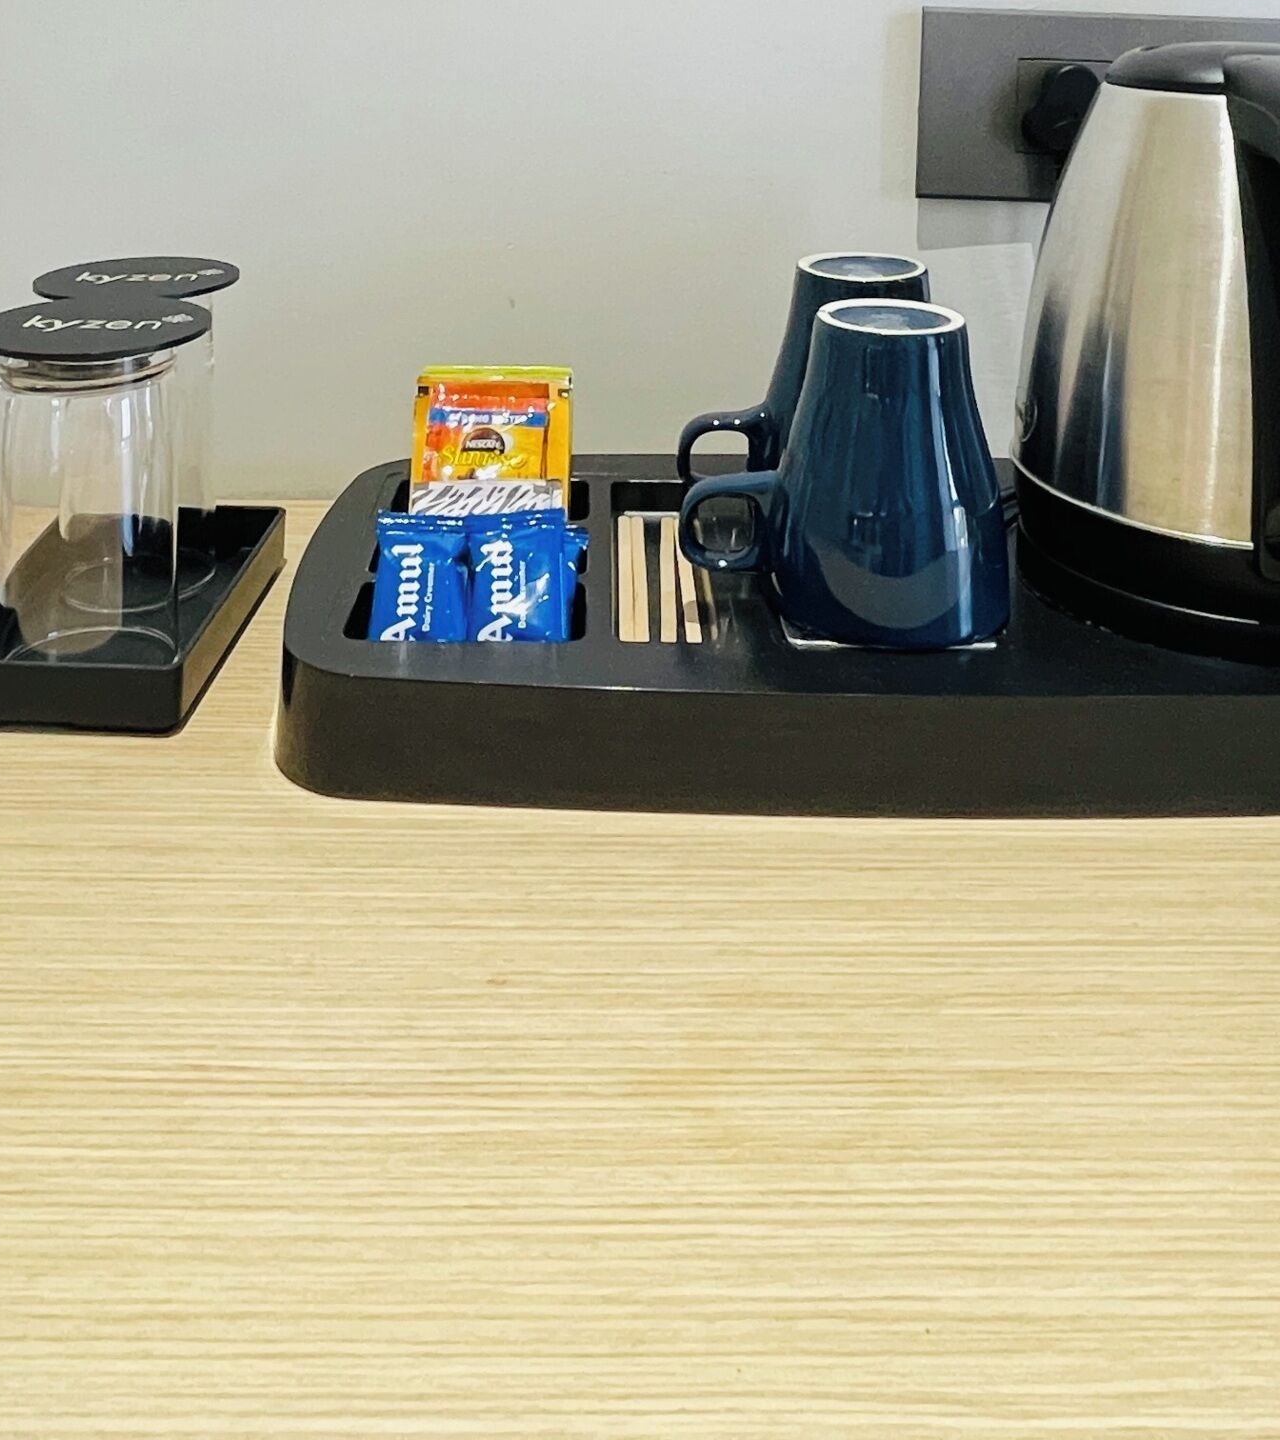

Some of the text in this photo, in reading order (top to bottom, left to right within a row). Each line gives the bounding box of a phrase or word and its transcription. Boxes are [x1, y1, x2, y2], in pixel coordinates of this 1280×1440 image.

[75, 271, 198, 285] kyzen
[22, 315, 162, 333] kyzen
[380, 543, 424, 641] Amul
[422, 562, 435, 632] Dairy Creamer
[477, 540, 513, 641] Amul
